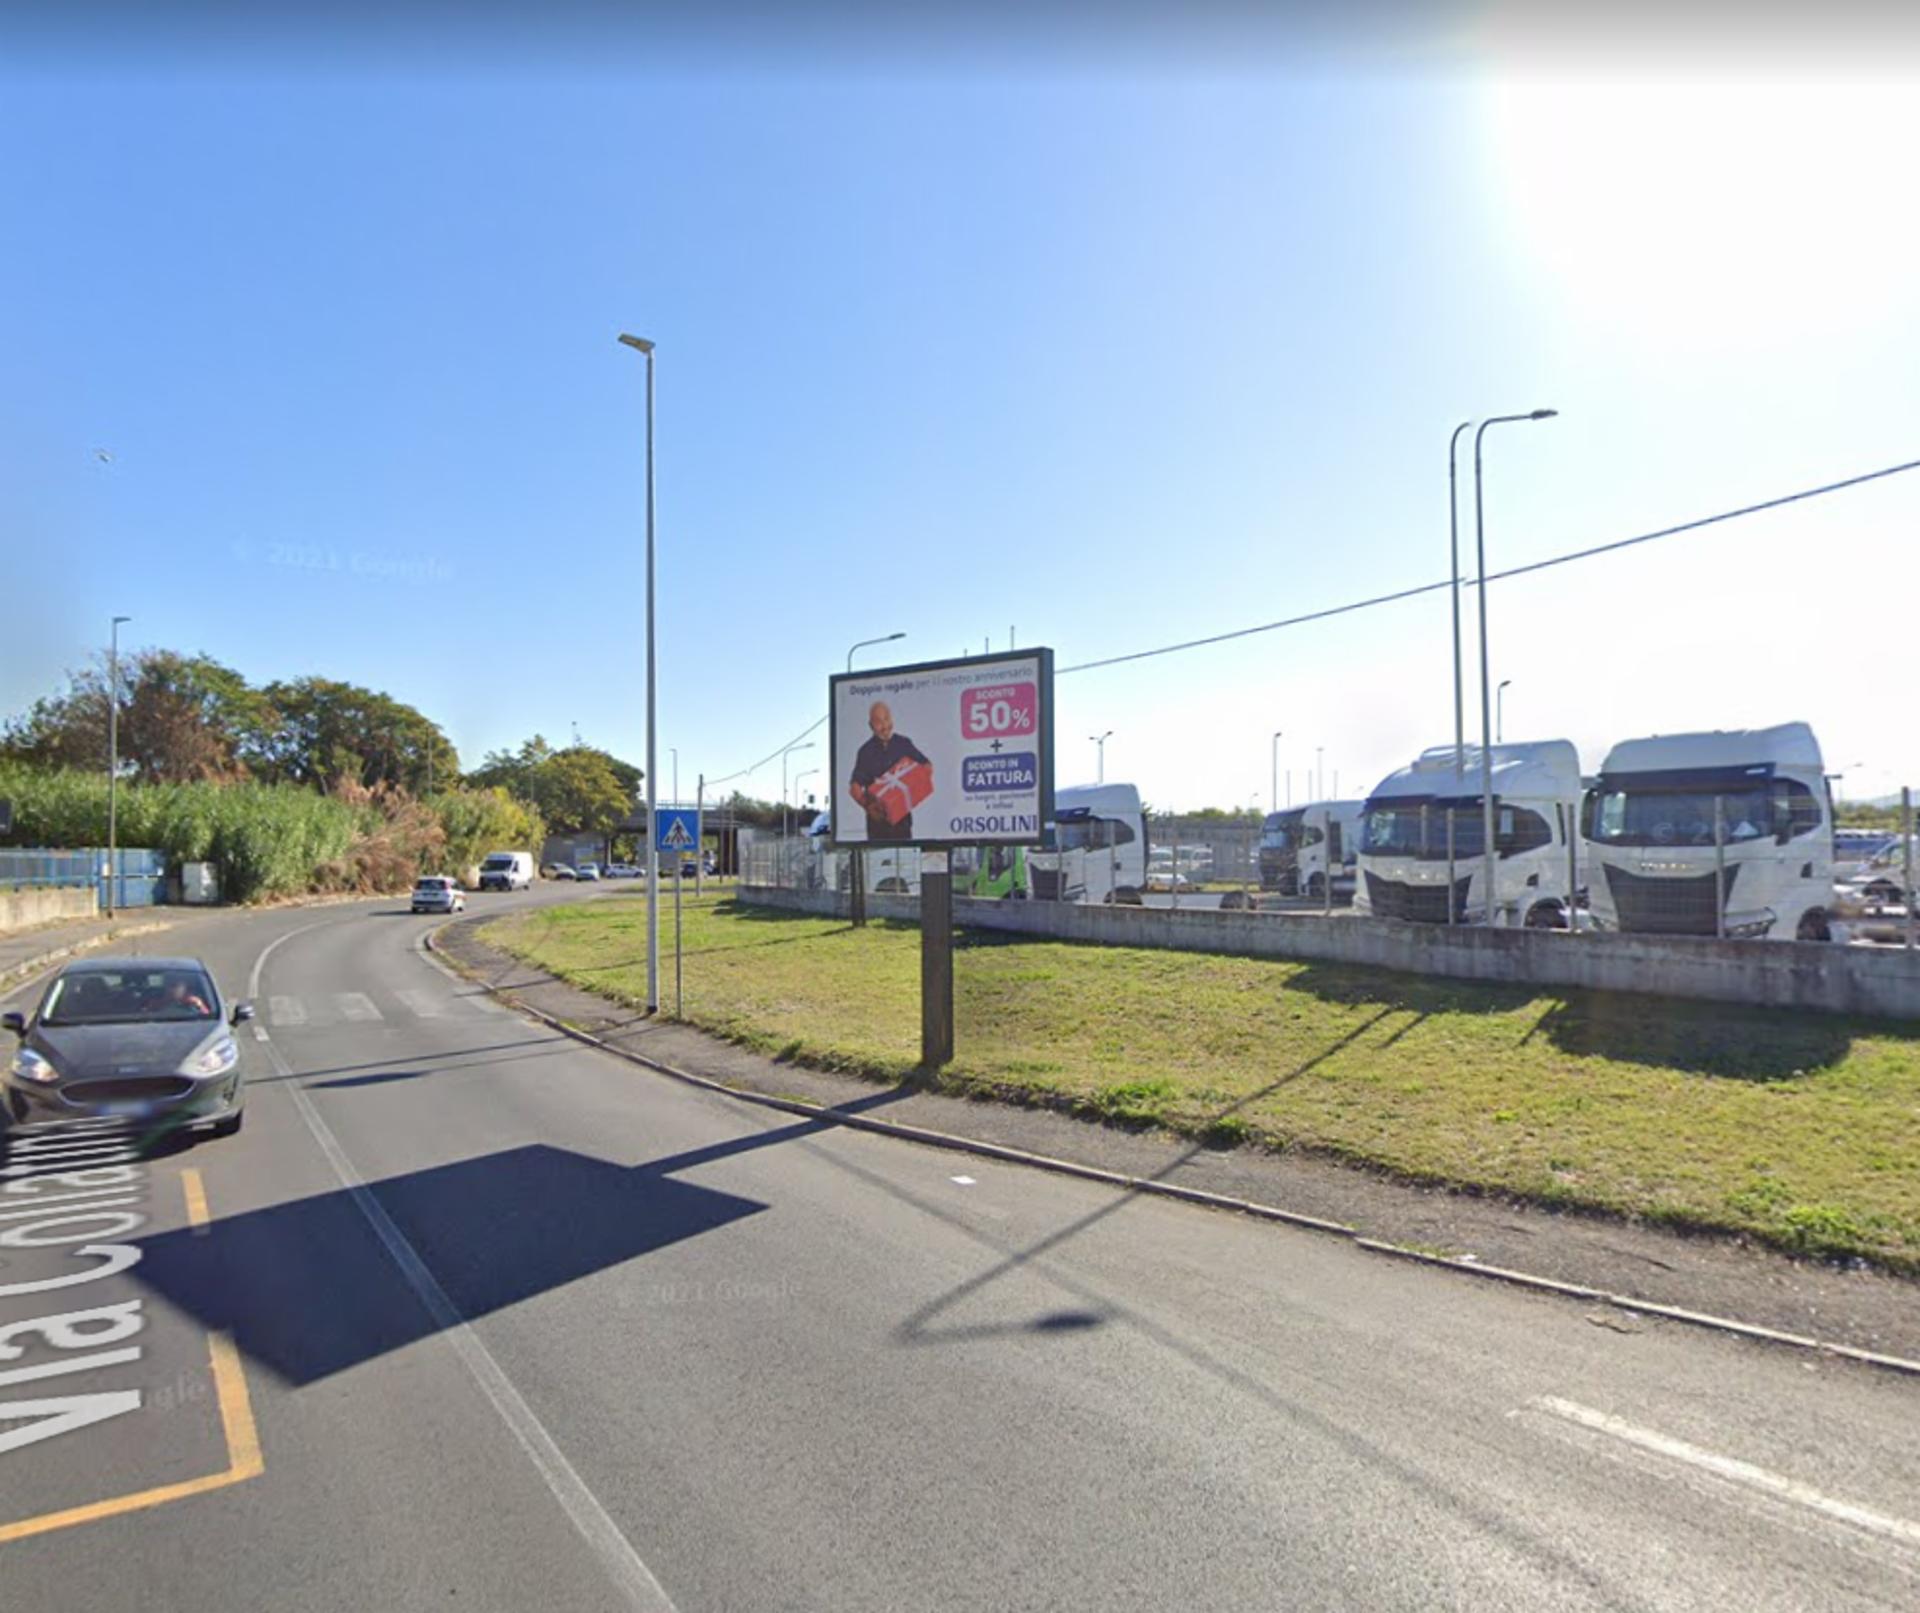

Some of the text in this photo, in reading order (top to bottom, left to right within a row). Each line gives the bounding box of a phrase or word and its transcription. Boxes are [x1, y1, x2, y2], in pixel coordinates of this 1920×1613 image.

[975, 687, 1016, 700] SCONTO
[969, 700, 1030, 733] 50%
[967, 758, 1019, 771] SCONTO IN
[967, 769, 1034, 786] FATTURA
[950, 815, 1037, 833] ORSOLINI
